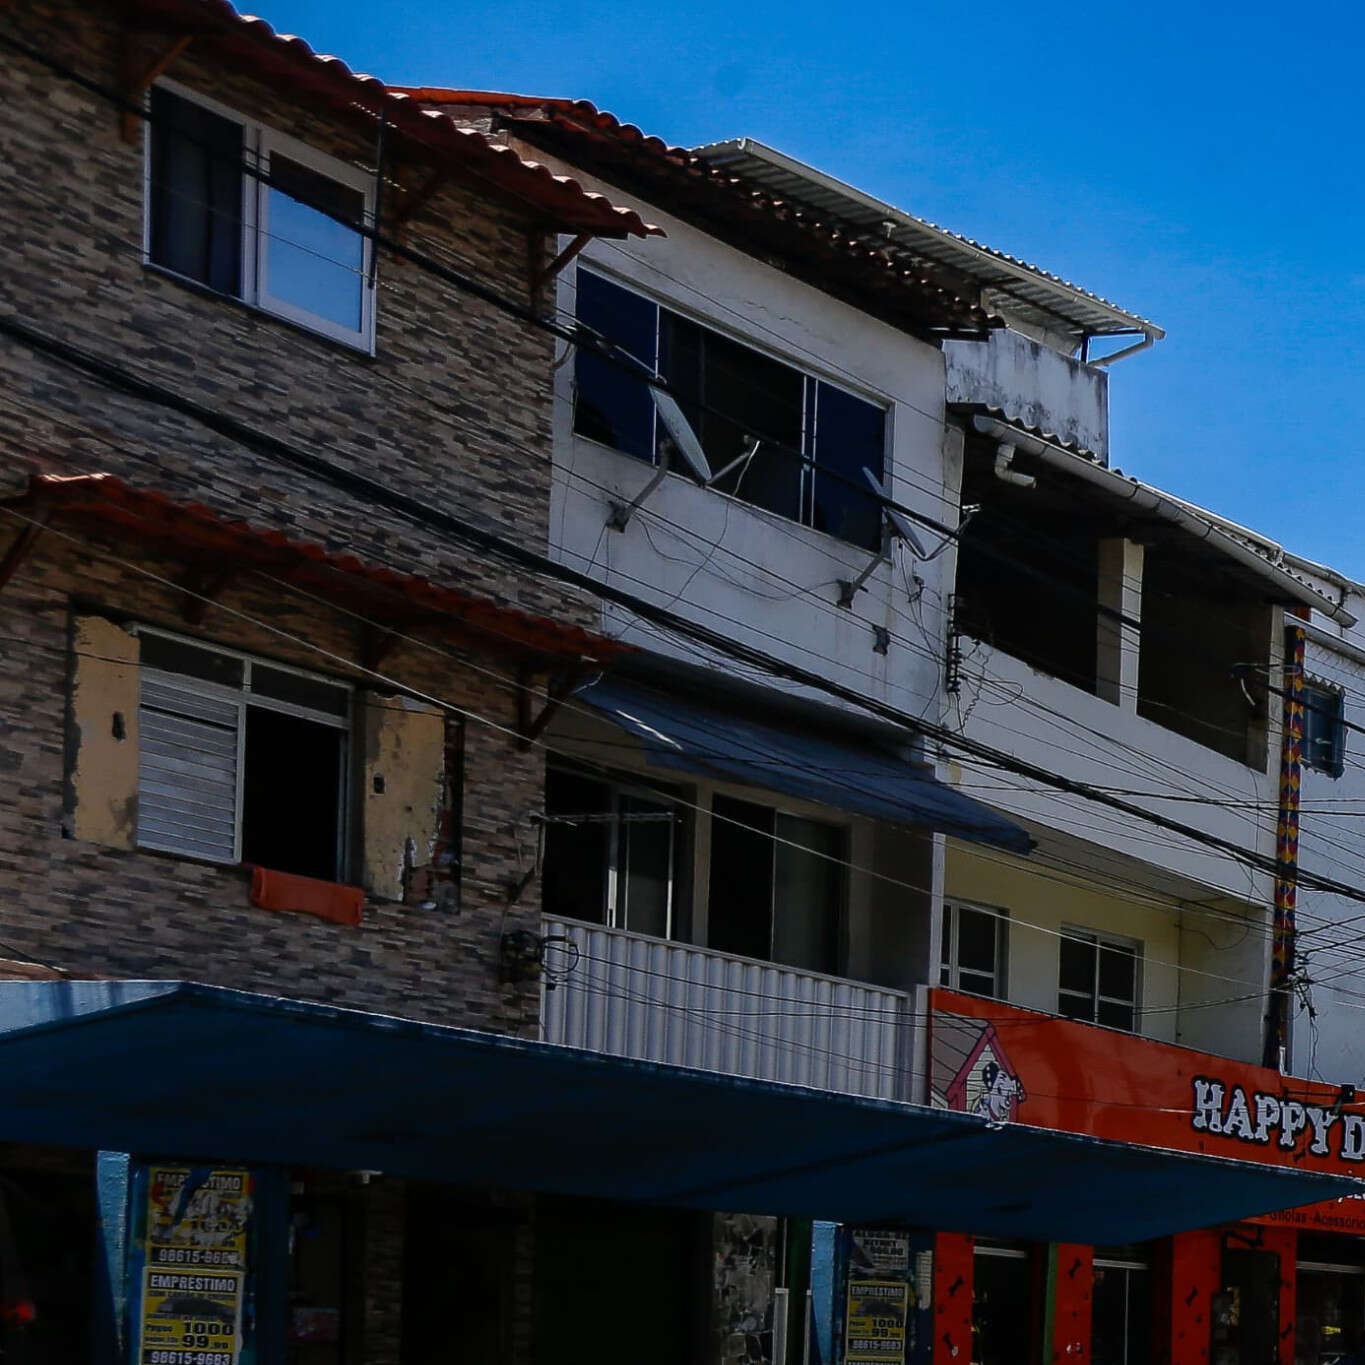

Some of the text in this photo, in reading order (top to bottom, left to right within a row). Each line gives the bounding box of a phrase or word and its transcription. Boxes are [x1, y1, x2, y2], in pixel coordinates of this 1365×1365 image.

[1192, 1077, 1339, 1157] HAPPY
[184, 1321, 234, 1336] 1000
[872, 1319, 904, 1328] 1000
